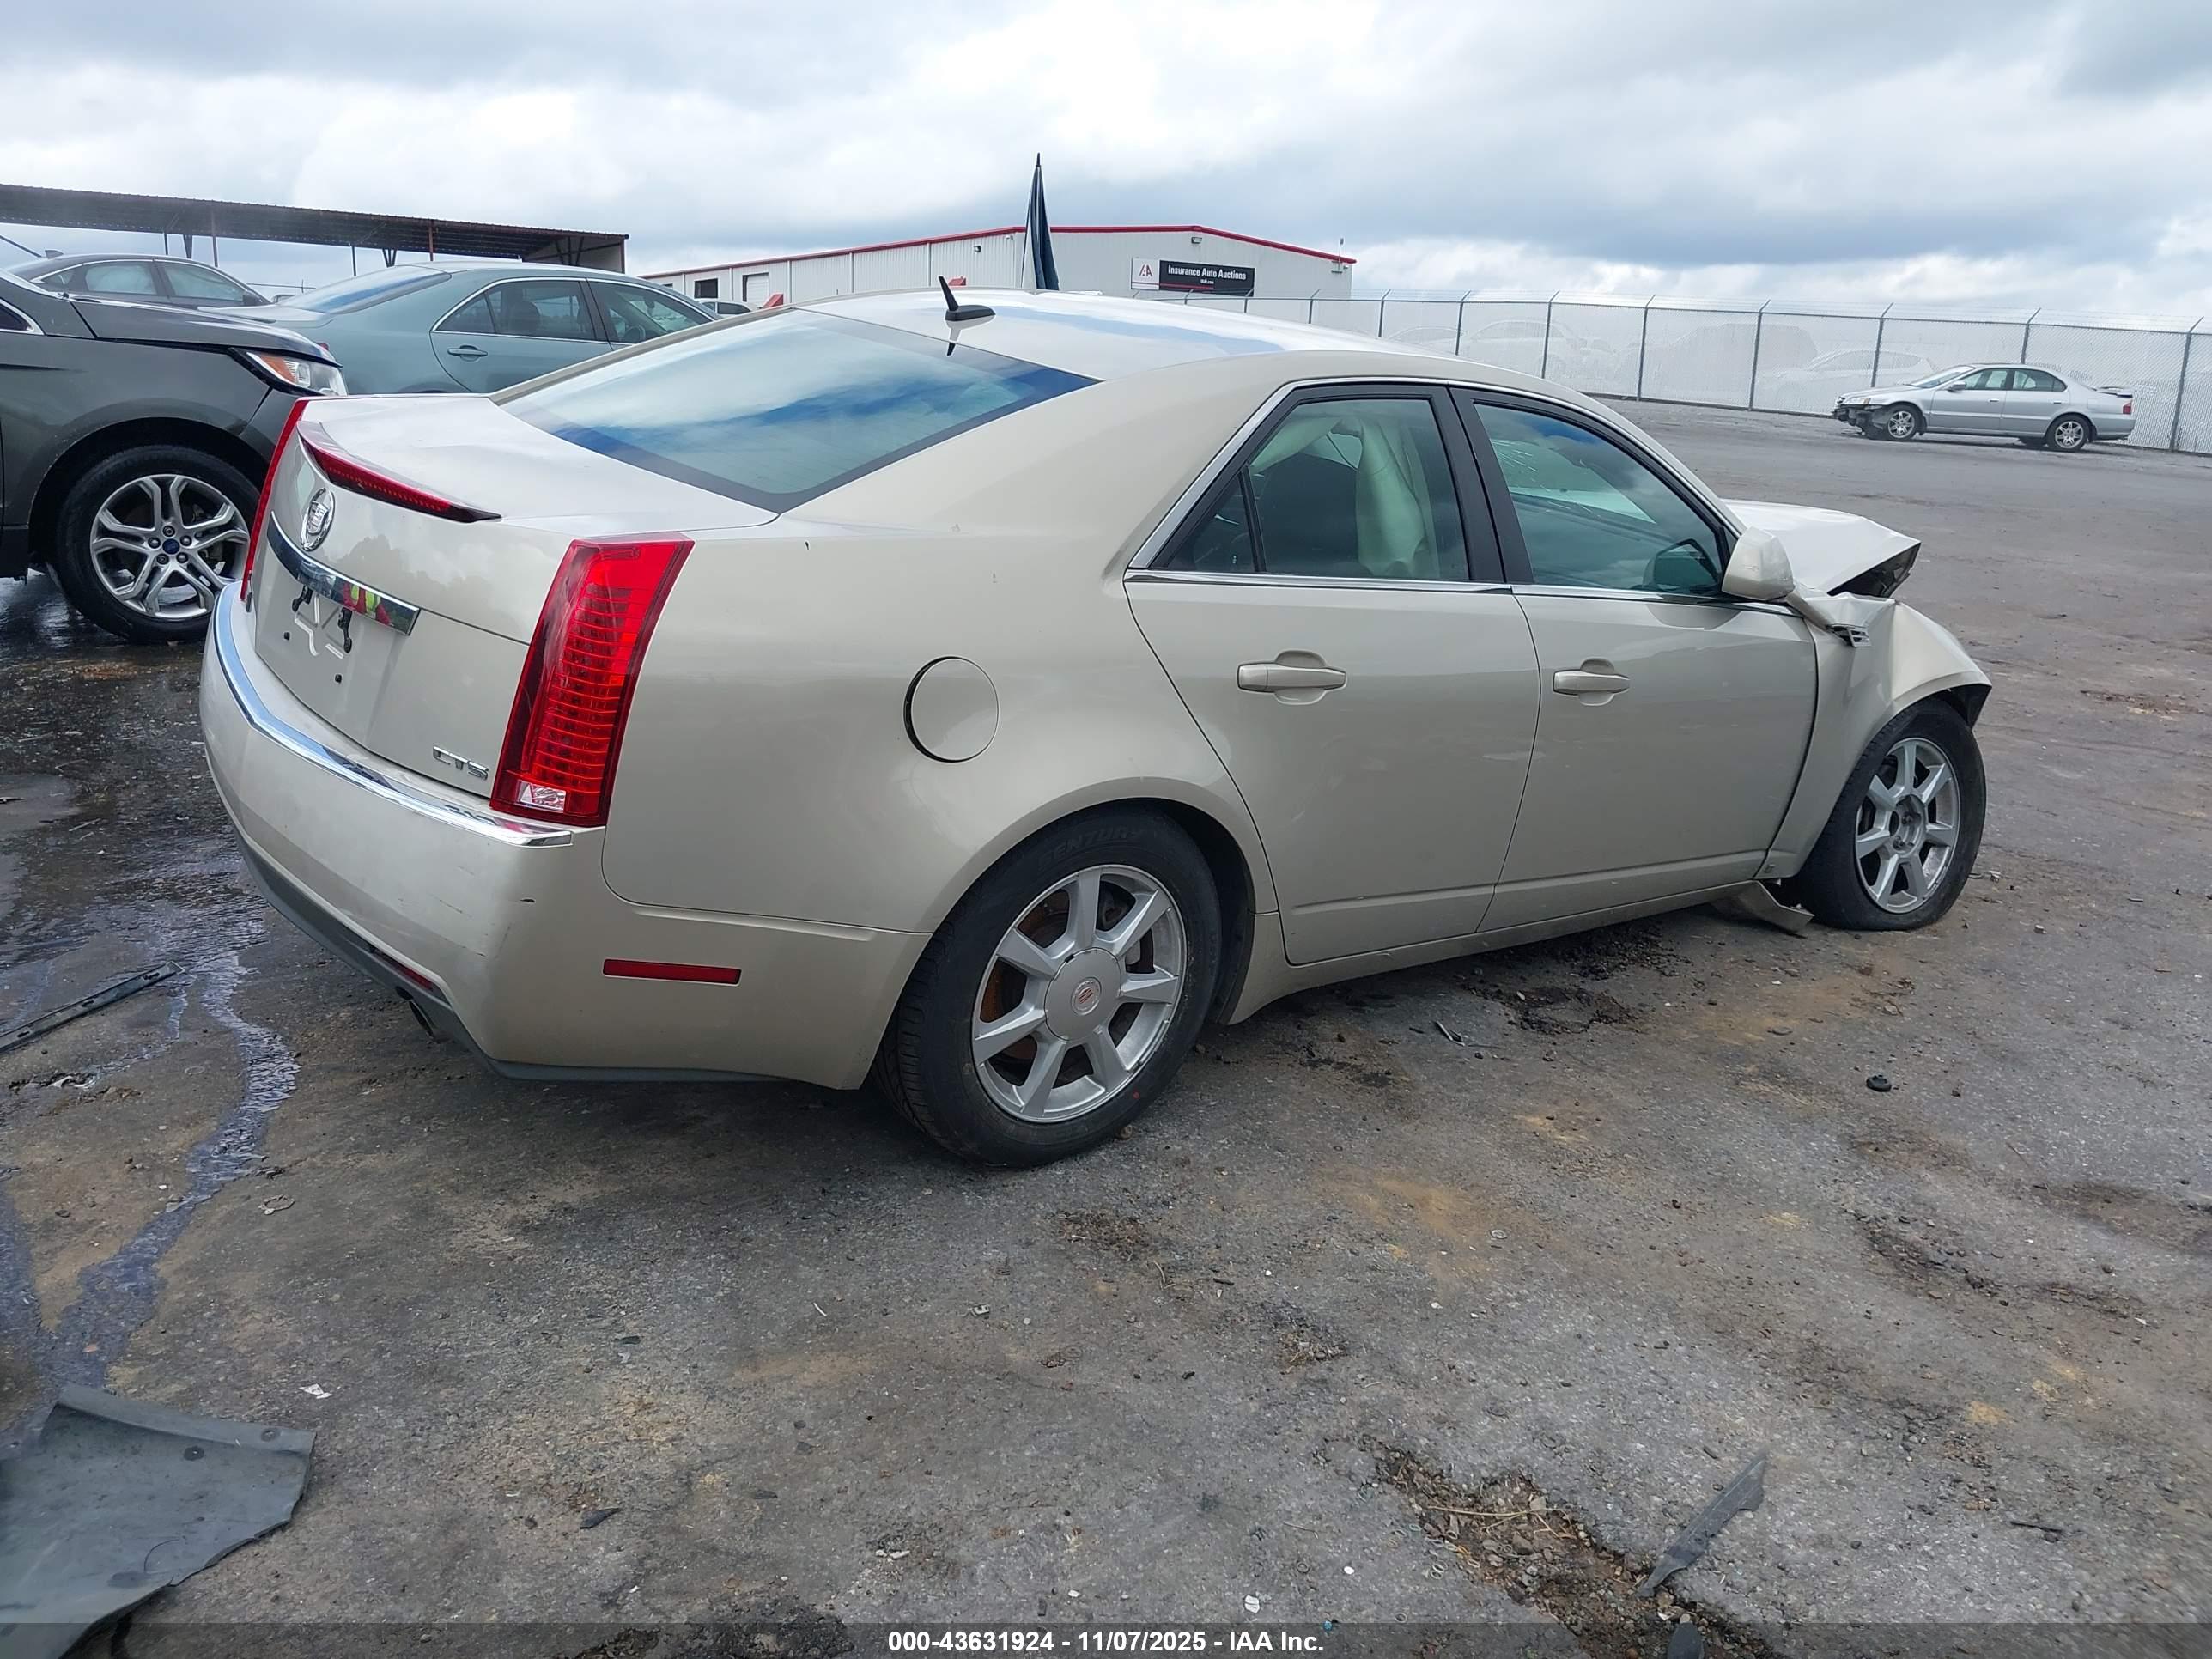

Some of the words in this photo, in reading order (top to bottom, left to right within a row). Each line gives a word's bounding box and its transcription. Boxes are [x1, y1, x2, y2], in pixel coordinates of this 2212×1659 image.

[1168, 264, 1200, 276] Insurance
[1201, 268, 1218, 277] Auto
[1218, 270, 1247, 280] Auctions
[432, 744, 489, 781] CTS
